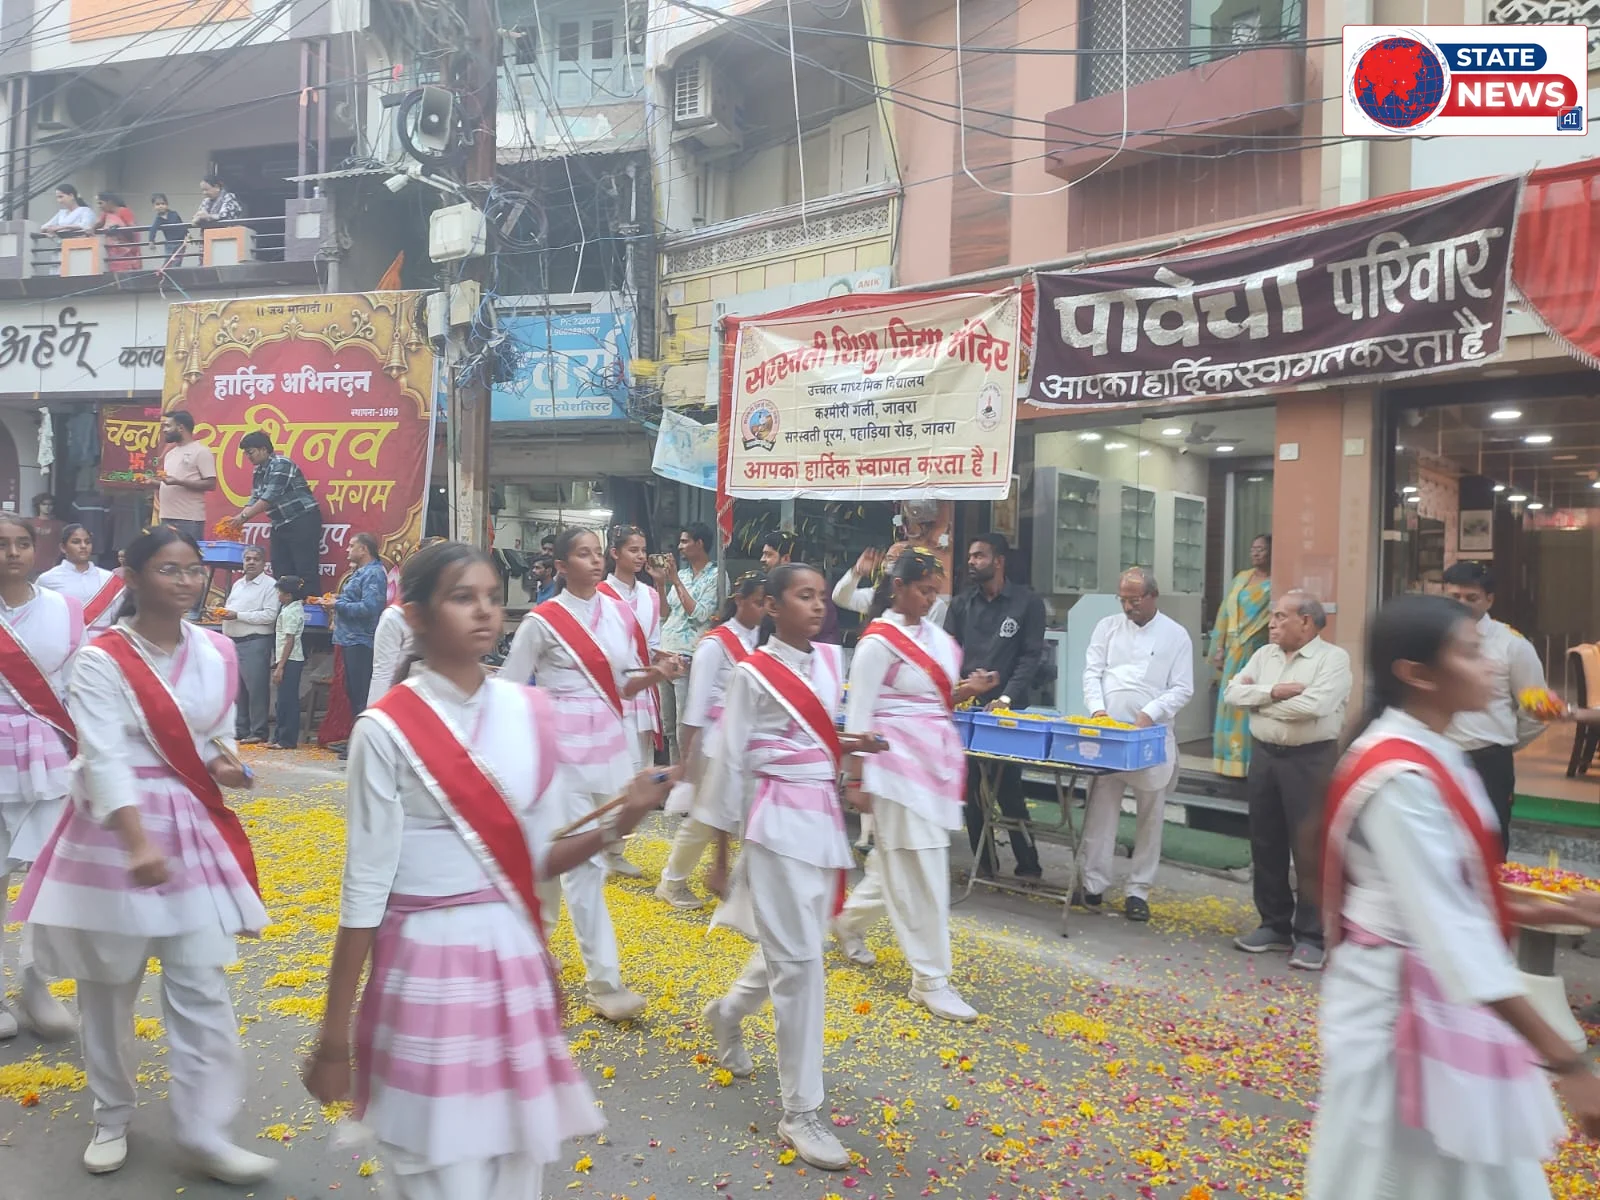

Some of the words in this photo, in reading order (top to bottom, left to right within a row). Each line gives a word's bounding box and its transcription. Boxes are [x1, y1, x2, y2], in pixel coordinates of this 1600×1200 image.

[268, 305, 284, 315] जय
[1053, 266, 1314, 357] पावेचा
[1327, 231, 1504, 320] परिवार
[745, 330, 828, 395] सरस्वती
[831, 325, 879, 375] शिशु
[888, 316, 944, 360] विद्या
[947, 318, 1011, 373] मंदिर
[1040, 371, 1142, 400] आपका
[1141, 356, 1238, 398] हार्दिक
[1234, 344, 1350, 389] स्वागत
[1349, 330, 1456, 368] करता
[1453, 307, 1493, 360] है
[214, 364, 276, 400] हार्दिक
[281, 363, 373, 398] अभिनंदन
[807, 383, 839, 397] उच्चतर
[534, 402, 551, 416] सूट
[814, 401, 849, 420] कश्मीरी
[882, 400, 918, 415] जावरा
[784, 426, 820, 444] सरस्वती
[850, 422, 891, 442] पहाड़िया
[921, 421, 956, 437] जावरा
[743, 460, 800, 480] आपका
[804, 451, 851, 481] हार्दिक
[855, 456, 912, 479] स्वागत
[917, 453, 966, 476] करता
[971, 444, 985, 478] है
[325, 469, 397, 515] संगम
